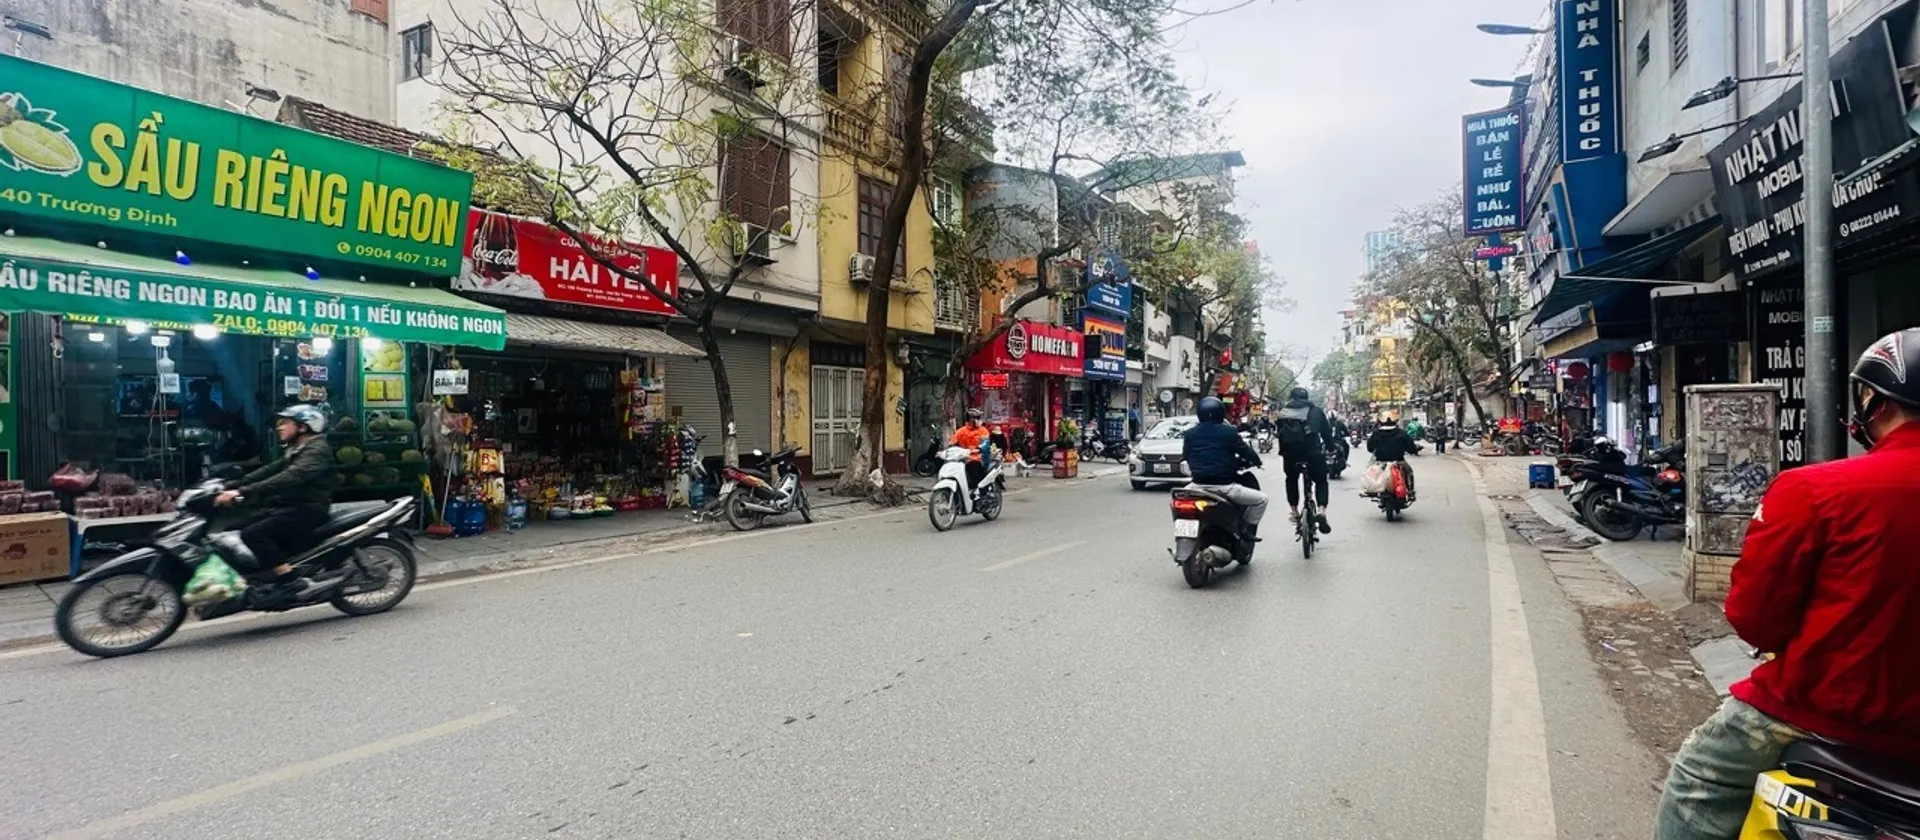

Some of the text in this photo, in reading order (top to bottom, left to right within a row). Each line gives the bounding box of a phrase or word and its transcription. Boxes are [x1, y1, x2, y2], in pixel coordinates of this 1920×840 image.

[1725, 123, 1777, 186] NHẬT
[87, 111, 460, 247] SẦU RIÊNG NGON
[1477, 180, 1512, 196] NHƯ
[1757, 154, 1804, 200] MOBIL
[38, 192, 121, 221] Trương
[127, 207, 177, 227] Định
[355, 244, 447, 268] 0904 407 134
[550, 255, 598, 285] HẢI
[0, 260, 502, 335] ẦU RIÊNG NGON BAO ĂN 1 ĐỔI 1 NẾU KHÔNG NGON
[212, 313, 262, 330] ZALO:
[267, 318, 305, 334] 0904
[310, 321, 338, 336] 407
[1766, 339, 1792, 369] TRẢ
[1786, 432, 1802, 462] SỐ
